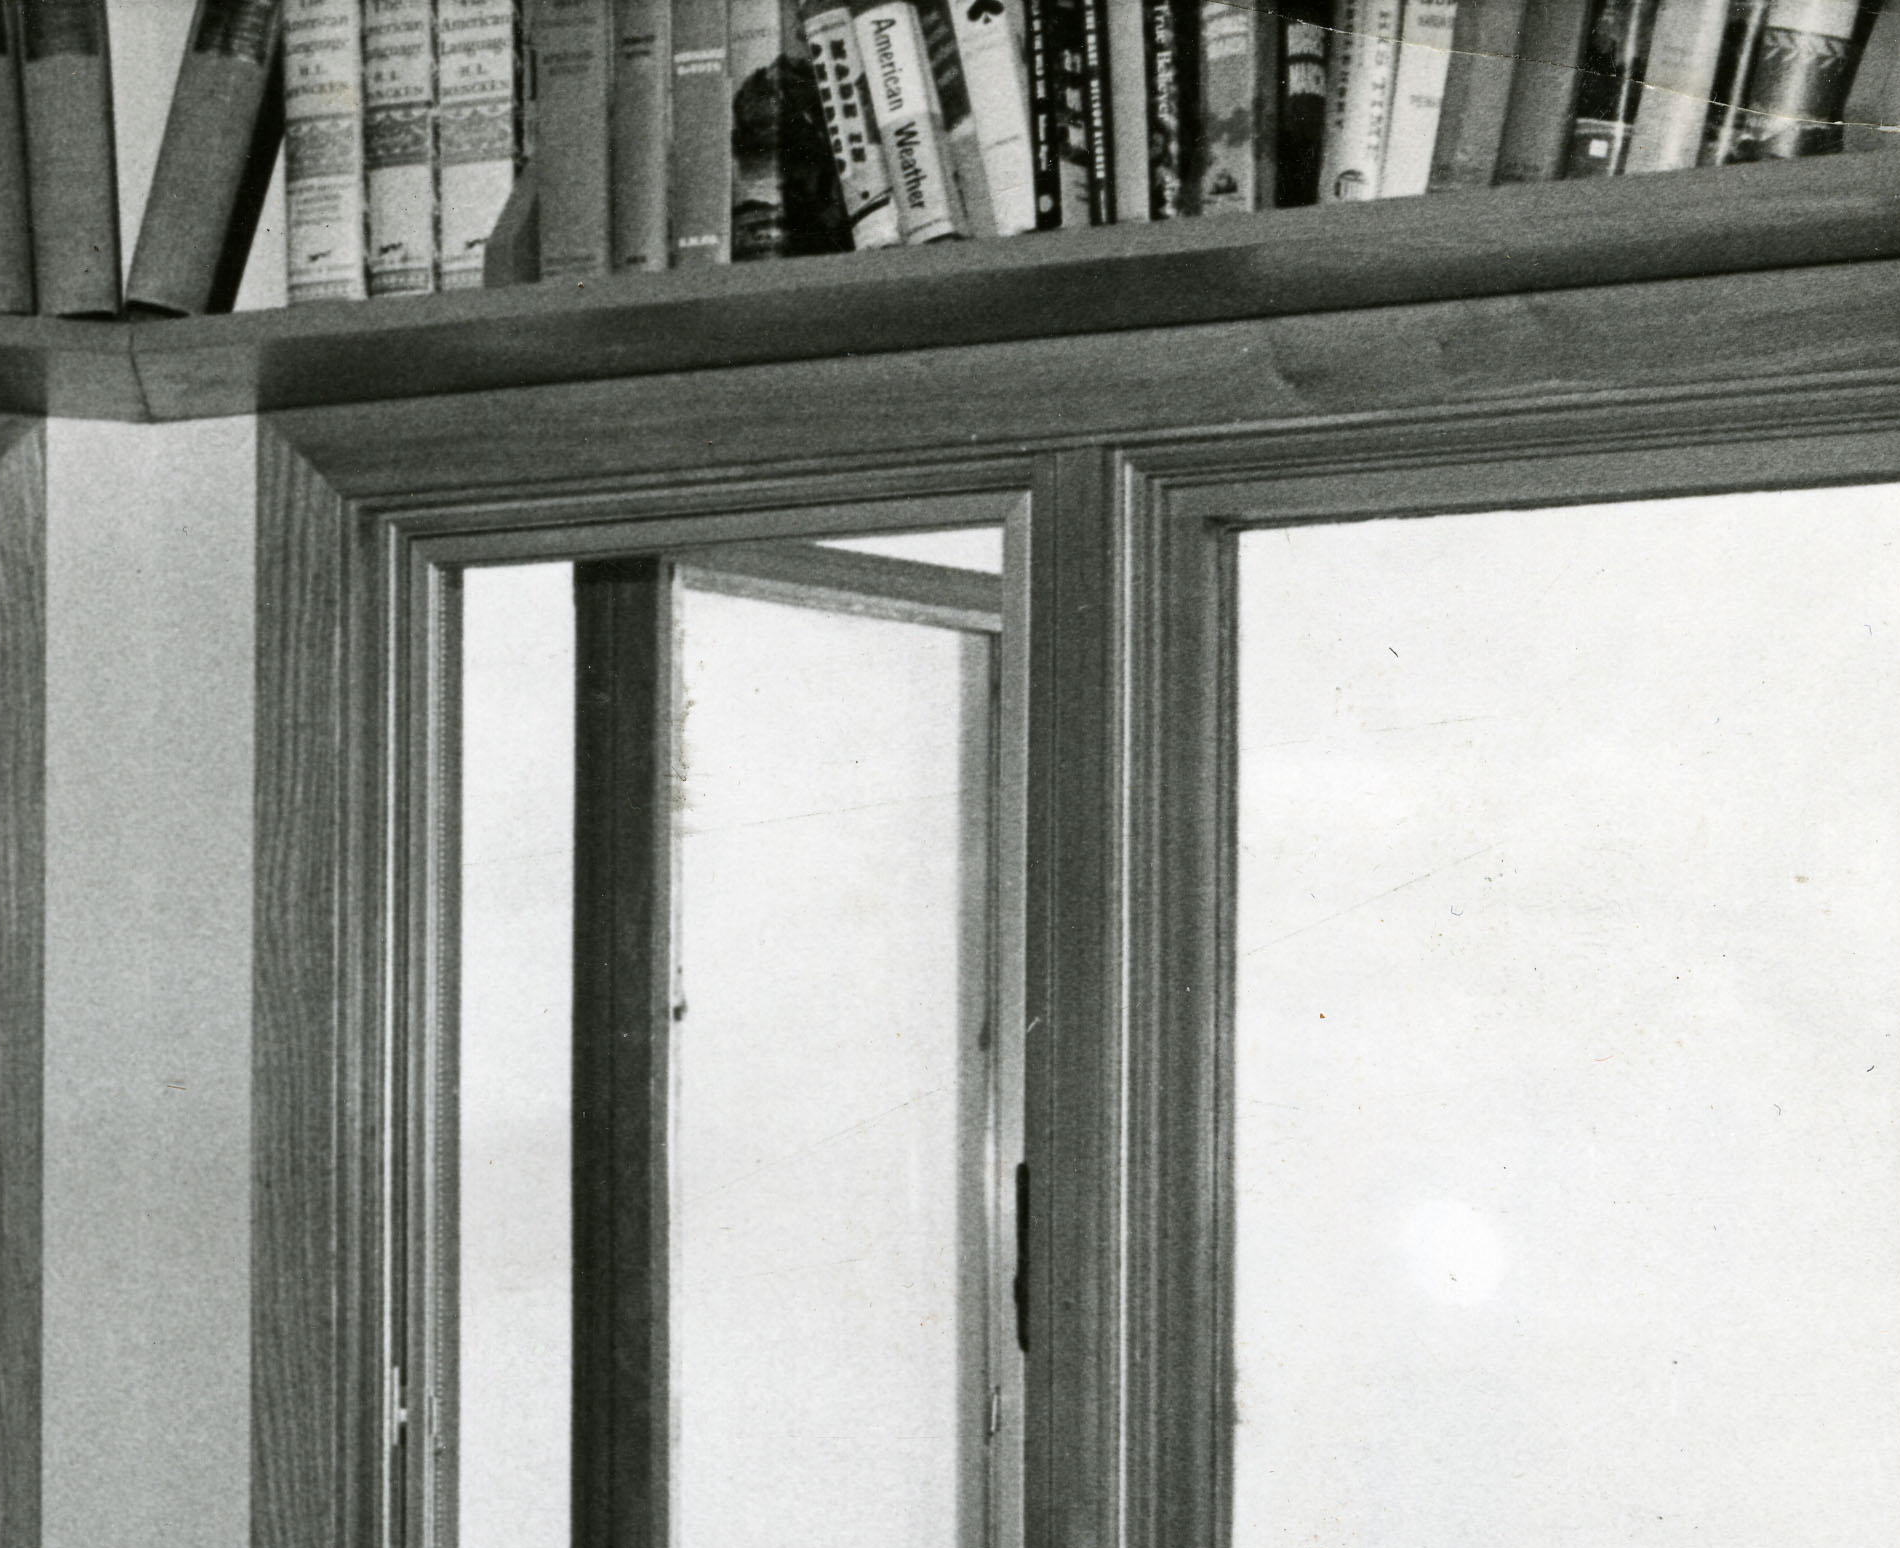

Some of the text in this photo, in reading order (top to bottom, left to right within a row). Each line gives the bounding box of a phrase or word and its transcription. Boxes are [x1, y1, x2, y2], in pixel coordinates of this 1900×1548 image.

[829, 39, 858, 119] MADE
[871, 18, 928, 210] American Weather
